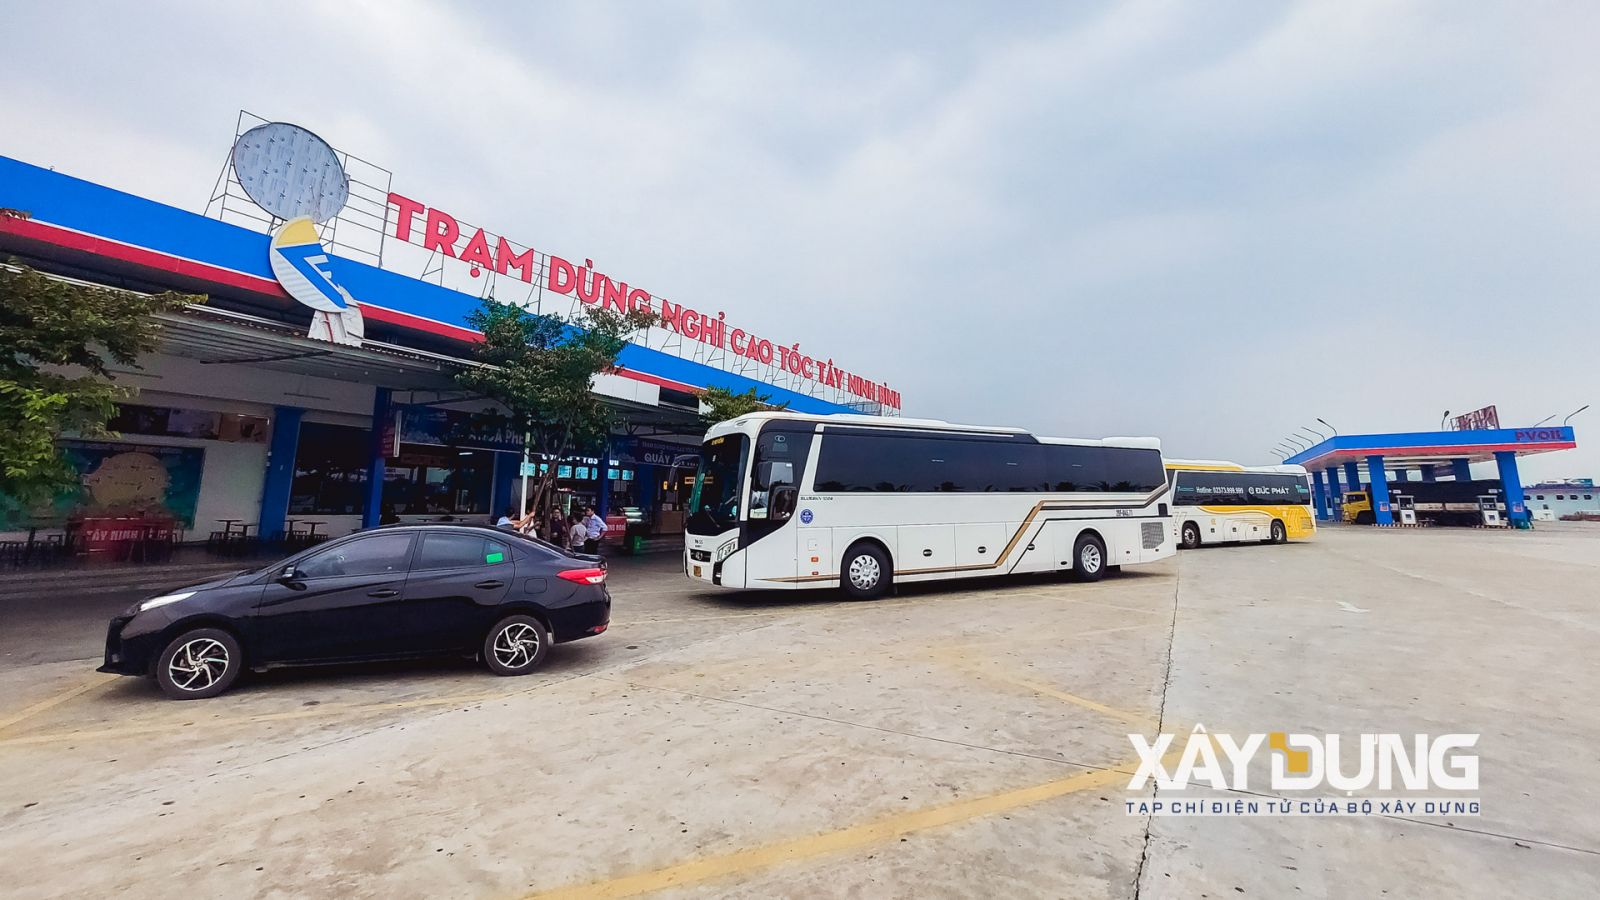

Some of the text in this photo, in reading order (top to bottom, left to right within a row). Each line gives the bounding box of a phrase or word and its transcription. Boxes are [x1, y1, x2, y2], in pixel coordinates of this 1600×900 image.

[387, 192, 901, 410] TRẠM DỪNG NGHỈ CAO TỐC TÂY NINH BÌNH
[1515, 429, 1566, 441] PVOIL
[1271, 486, 1290, 495] PHÁT
